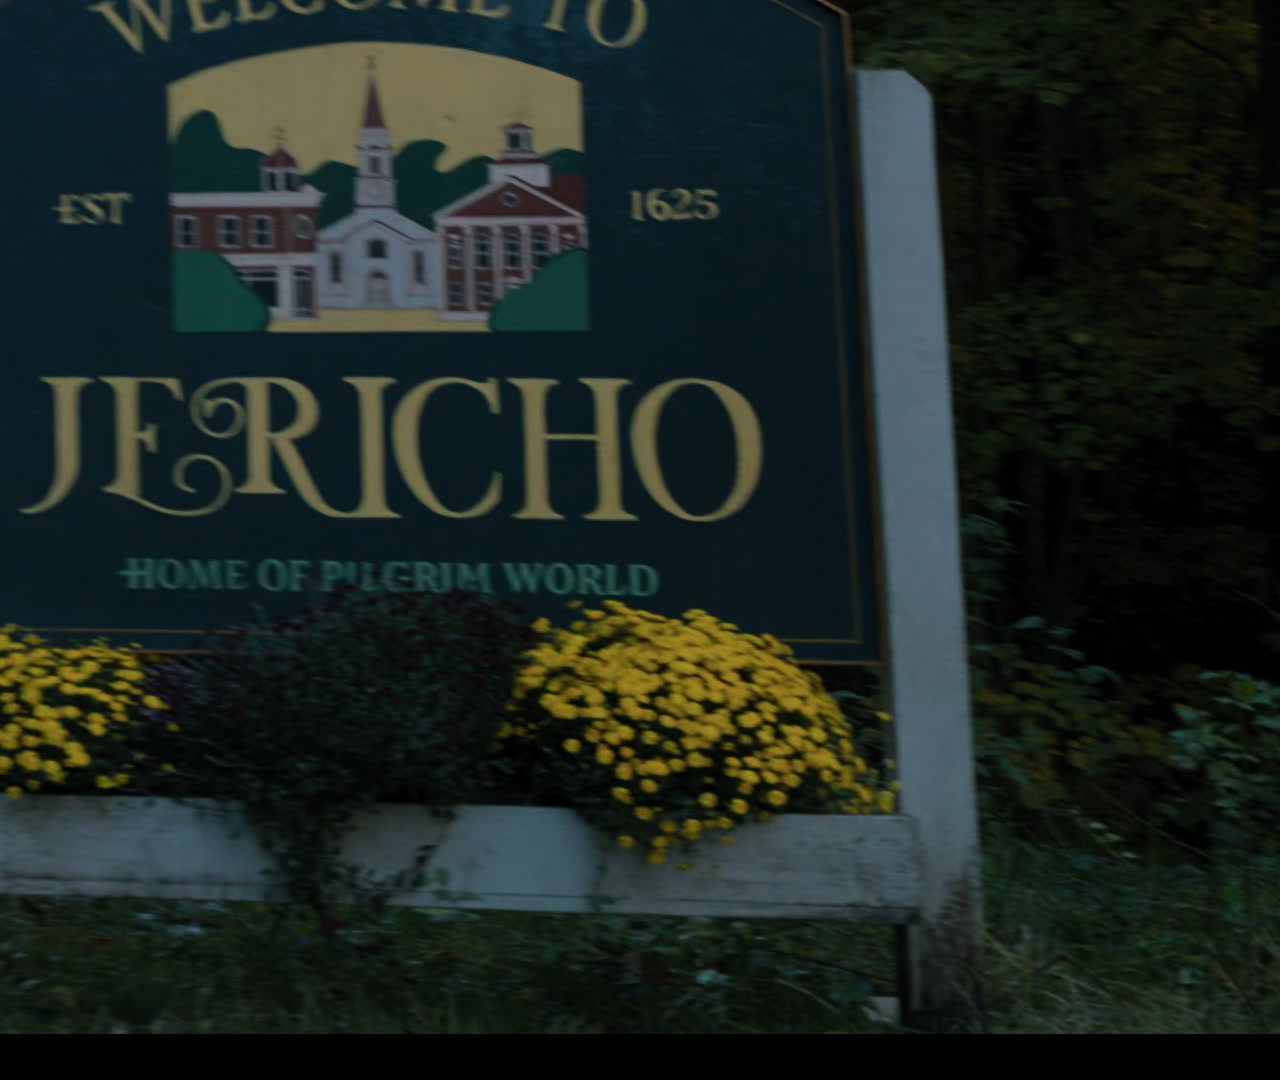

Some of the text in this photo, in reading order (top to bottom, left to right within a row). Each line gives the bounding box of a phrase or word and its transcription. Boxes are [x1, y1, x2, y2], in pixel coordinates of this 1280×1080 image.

[50, 192, 134, 226] EST
[628, 187, 720, 222] 1625
[18, 376, 763, 522] JERICHO
[115, 557, 660, 597] HOME OF PILGRIM WORLD
